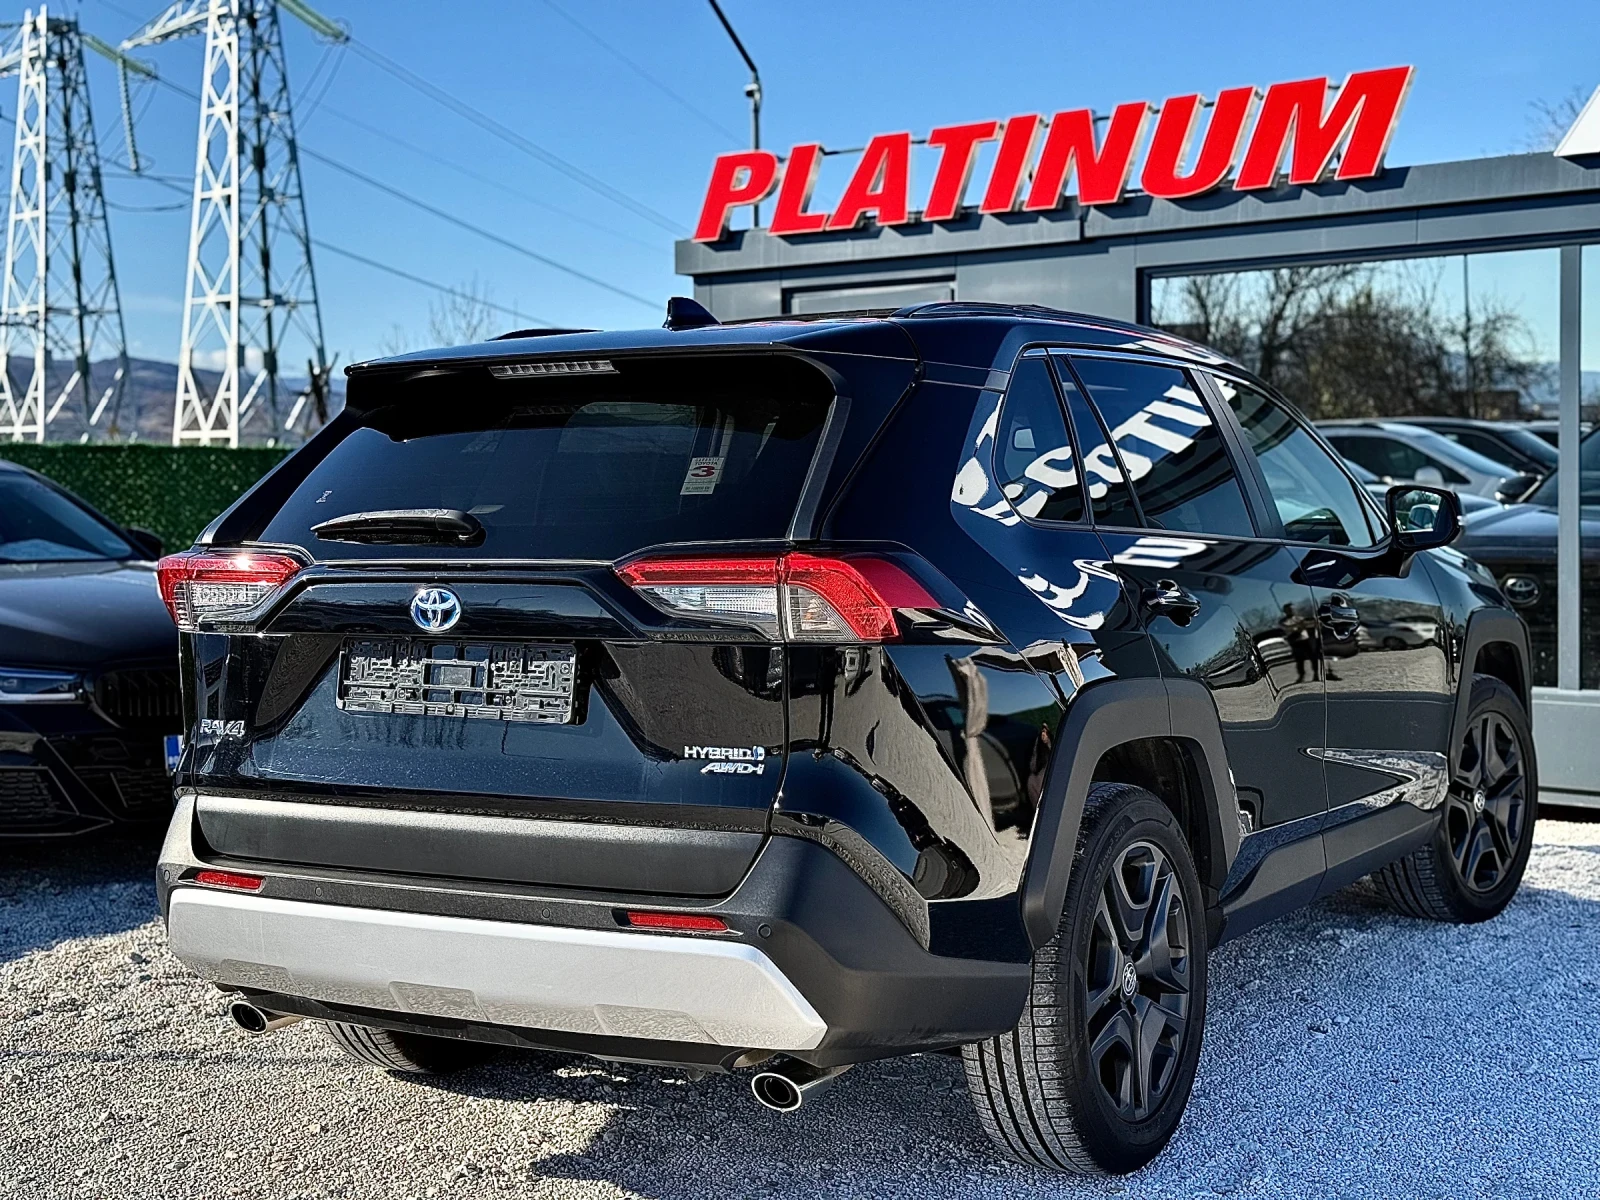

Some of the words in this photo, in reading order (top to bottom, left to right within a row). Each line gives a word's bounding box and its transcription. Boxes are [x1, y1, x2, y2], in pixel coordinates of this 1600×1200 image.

[692, 65, 1414, 243] PLATINUM
[690, 465, 715, 478] 3
[200, 718, 246, 737] RAV4
[684, 744, 754, 760] HYBRID
